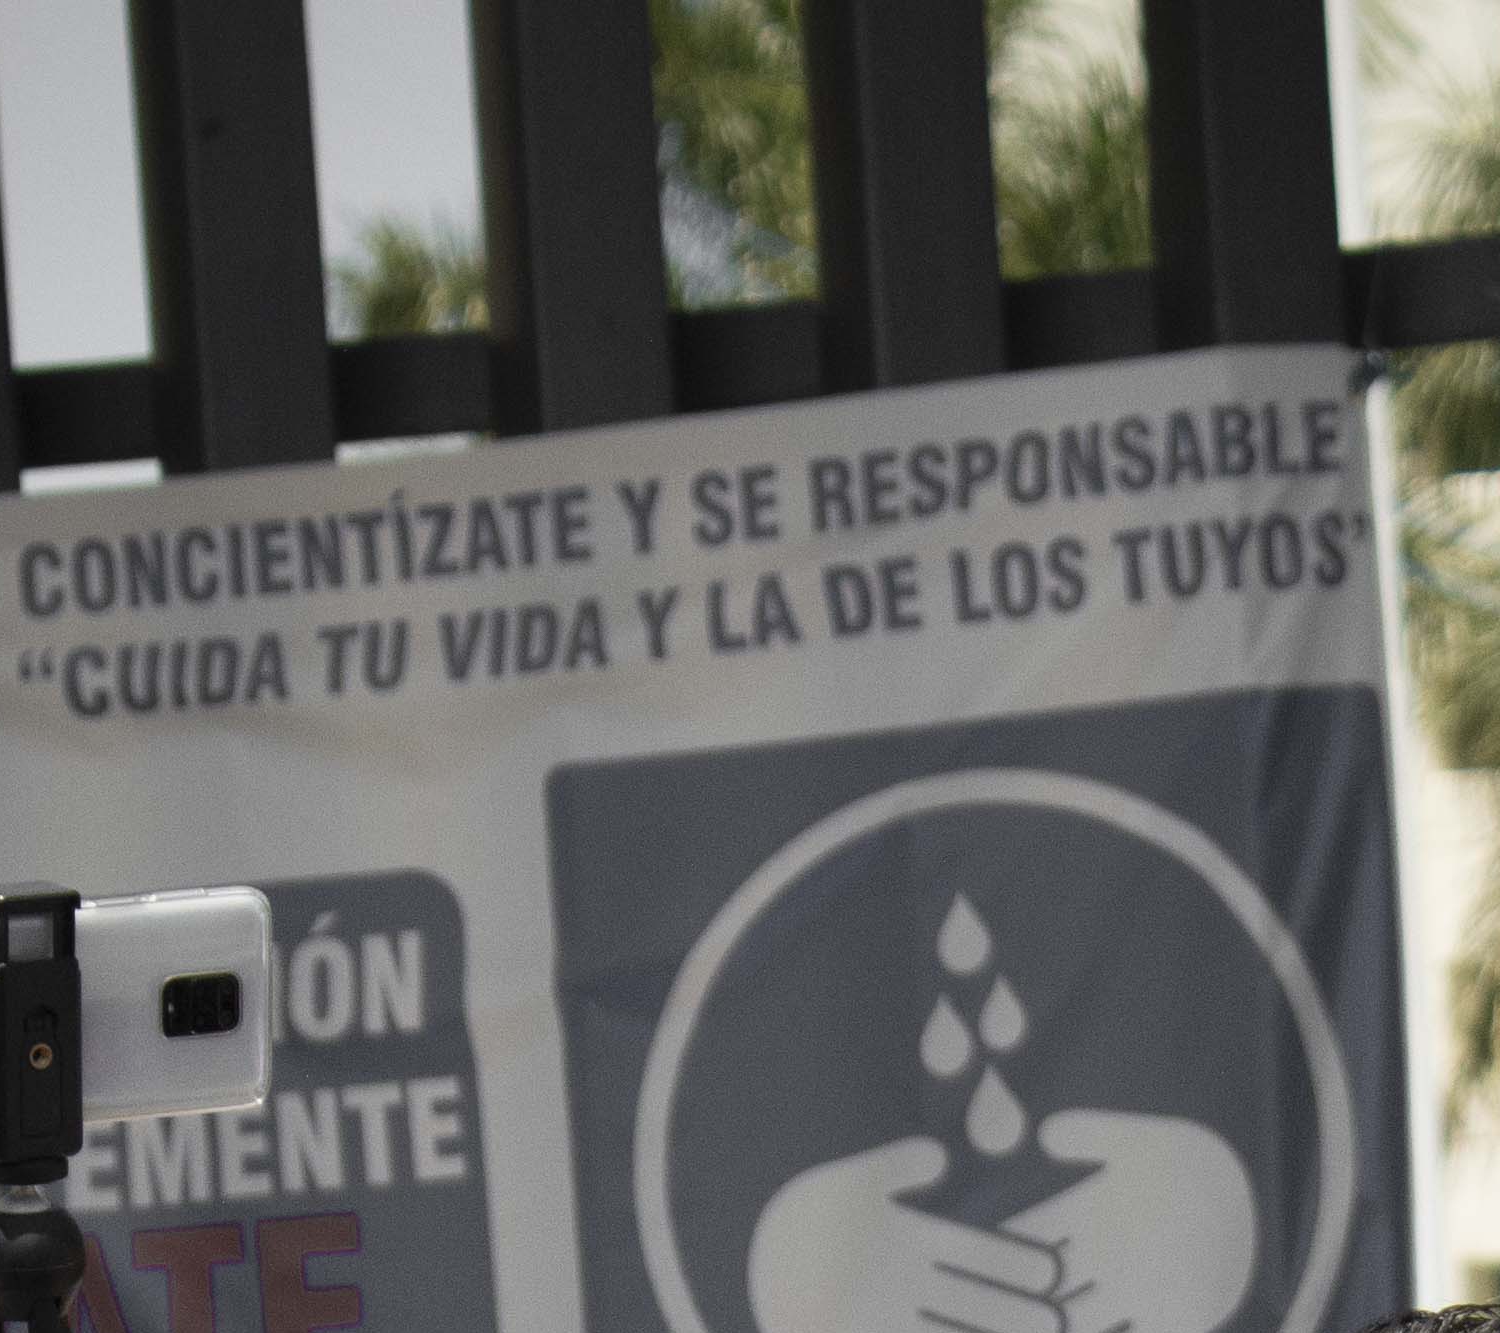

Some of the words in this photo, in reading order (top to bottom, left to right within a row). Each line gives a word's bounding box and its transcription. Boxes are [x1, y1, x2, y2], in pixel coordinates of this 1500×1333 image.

[19, 486, 592, 618] CONCIENTÍZATE
[615, 480, 663, 553] Y
[690, 466, 779, 546] SE
[811, 401, 1341, 534] RESPONSABLE
[319, 622, 410, 693] TU
[441, 600, 609, 682] VIDA
[634, 587, 686, 660] Y
[708, 575, 799, 654] LA
[829, 558, 920, 639] DE
[950, 538, 1087, 625] LOS
